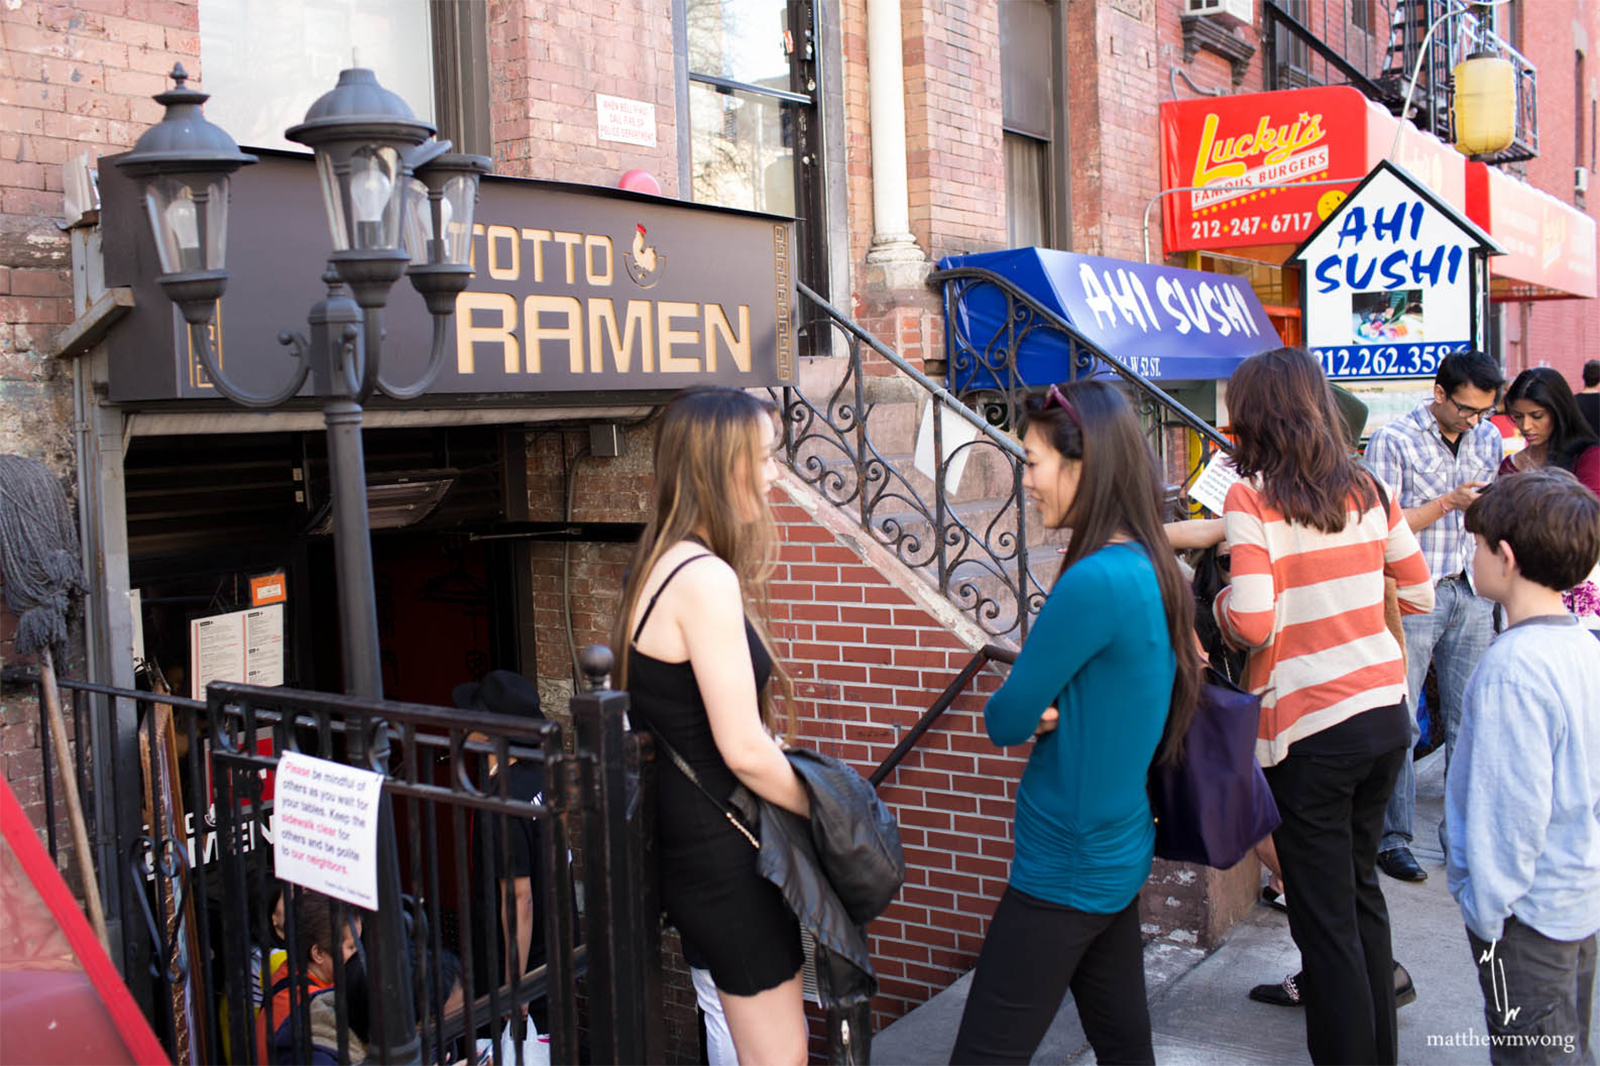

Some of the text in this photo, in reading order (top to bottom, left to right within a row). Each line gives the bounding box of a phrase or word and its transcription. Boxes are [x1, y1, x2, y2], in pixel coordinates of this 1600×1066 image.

[1191, 111, 1326, 188] Lucky's
[1195, 152, 1326, 204] FAMOUS BURGERS
[1337, 201, 1424, 249] AHI
[452, 222, 614, 286] TOTTO
[1315, 245, 1462, 294] SUSHI
[1079, 263, 1260, 338] AHI SUSHI
[456, 291, 751, 374] RAMEN
[1312, 344, 1467, 376] 12.262.358
[282, 780, 369, 811] others as you wait for
[284, 761, 366, 791] Please be mindful of
[281, 813, 350, 840] sidewalk clear for
[282, 798, 299, 809] your
[329, 808, 350, 825] Keep
[352, 815, 366, 827] the
[281, 830, 360, 862] others and be polite
[281, 845, 290, 856] to
[291, 849, 305, 861] our
